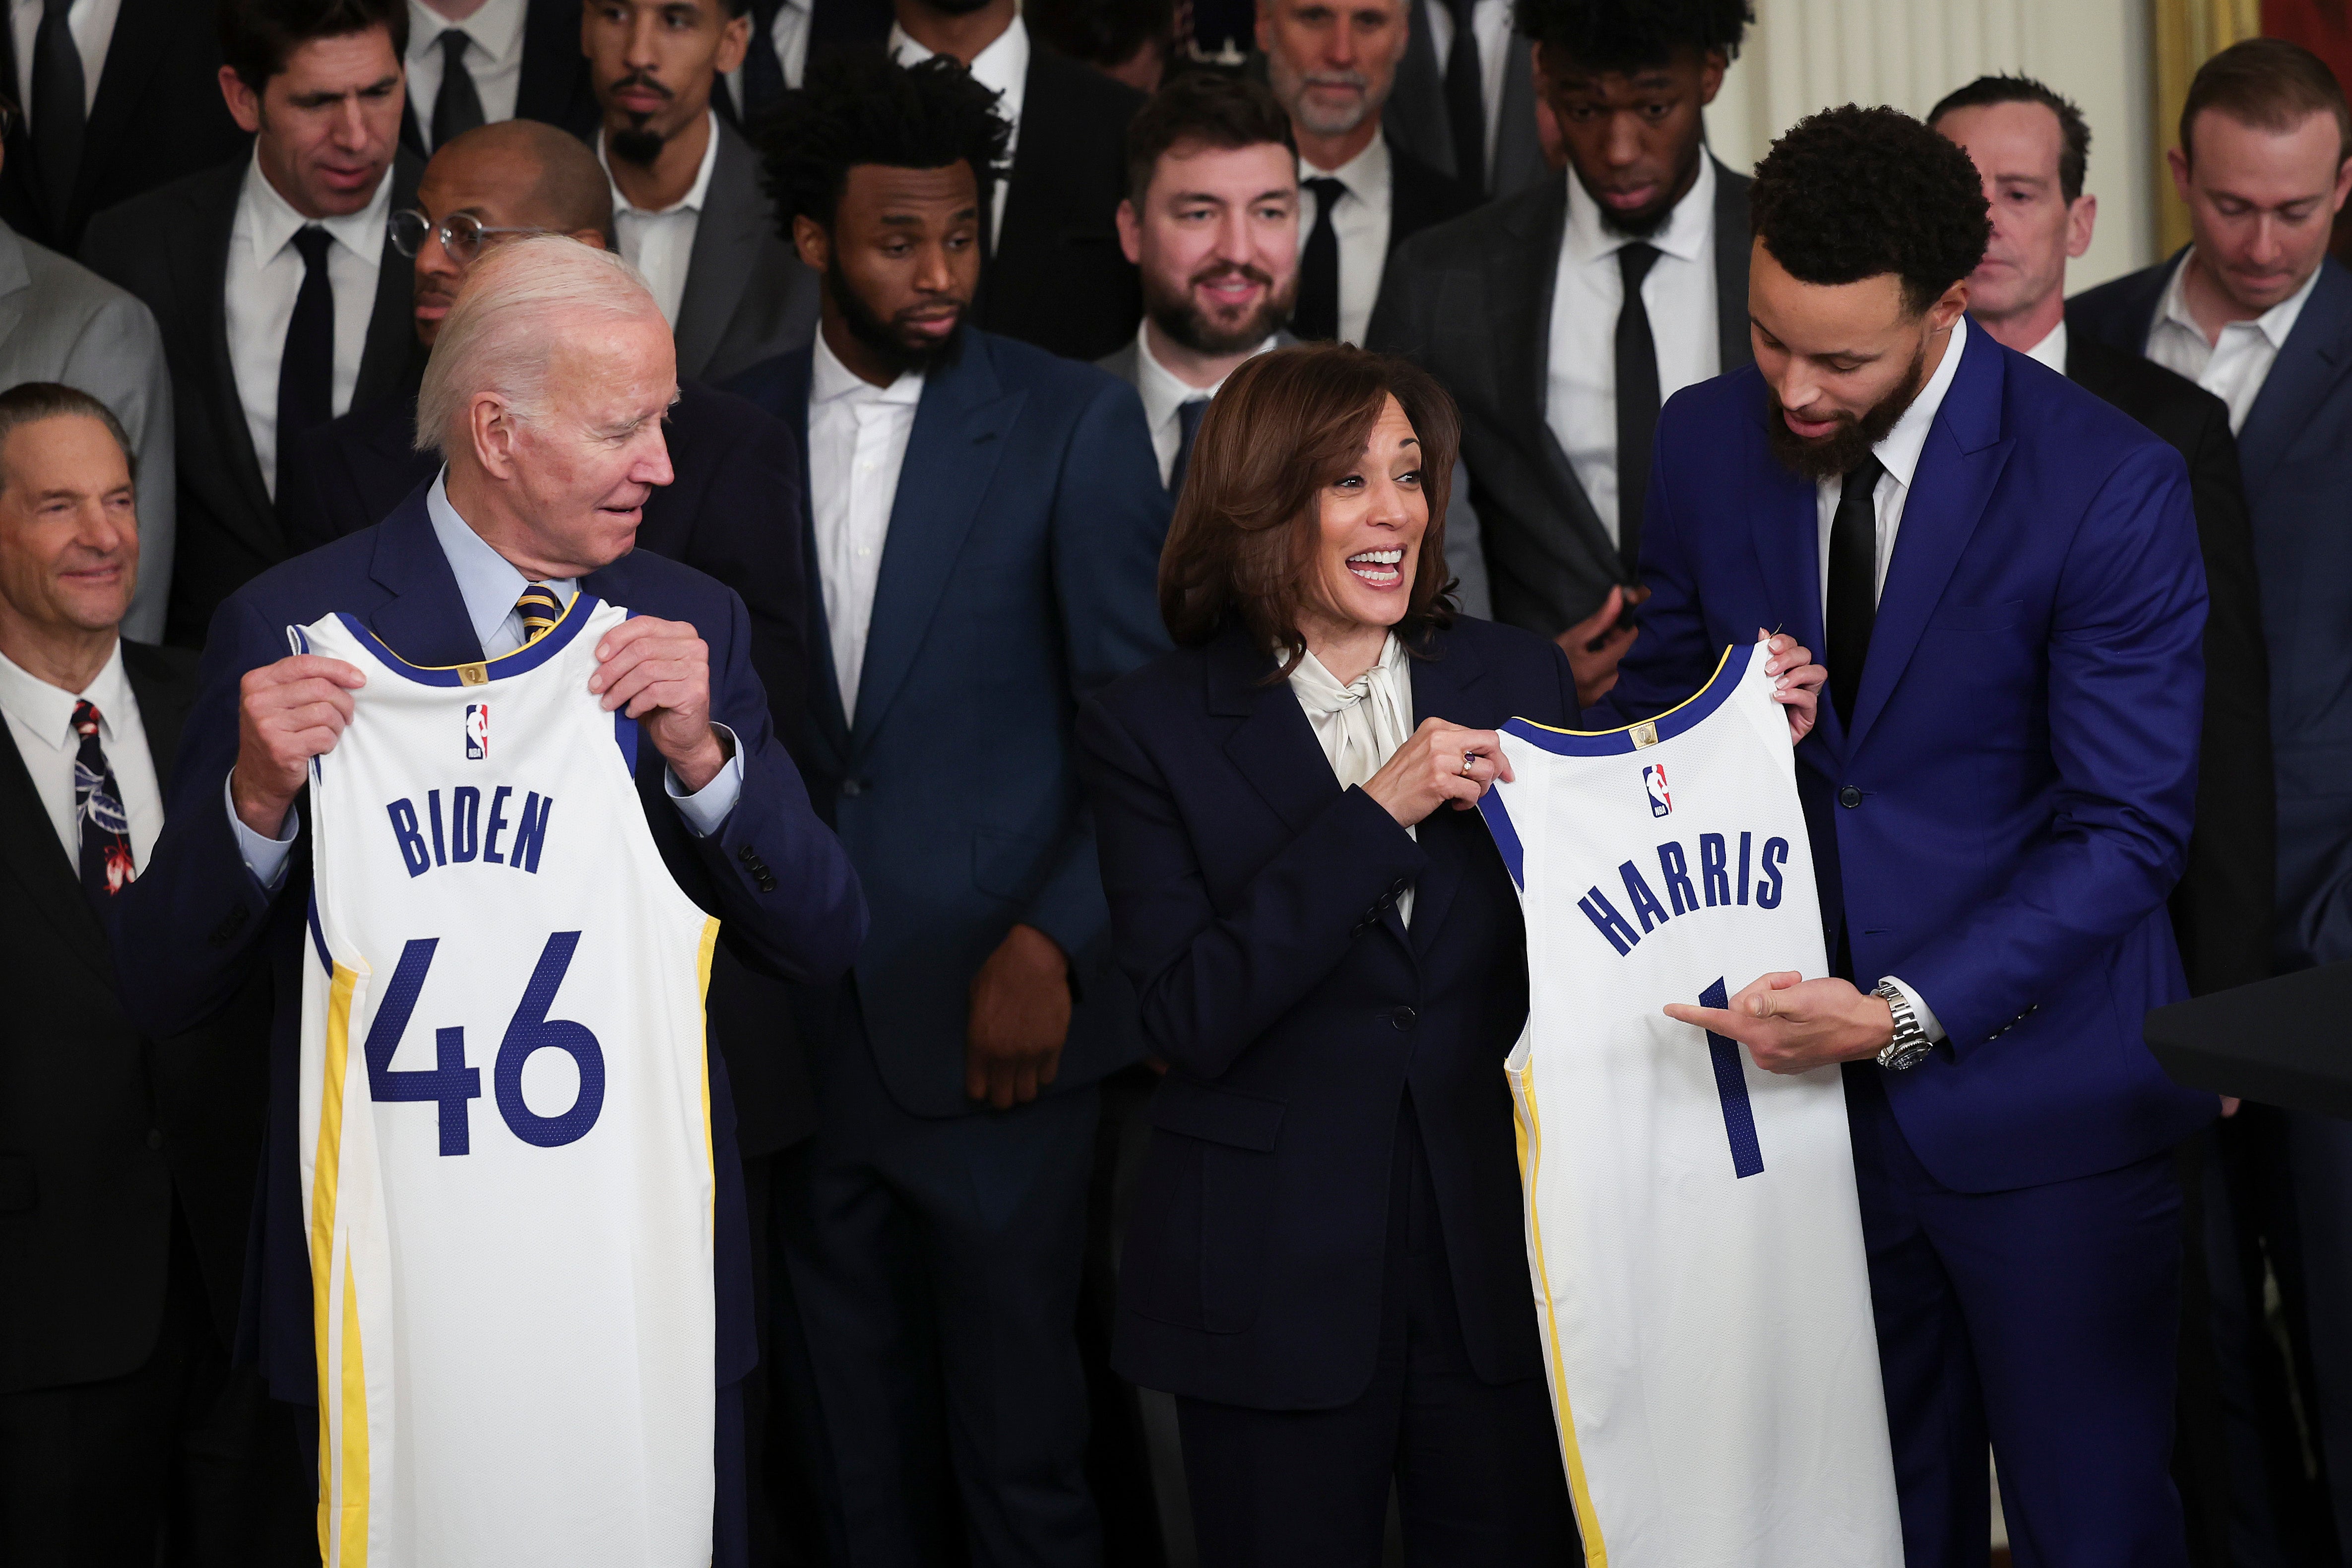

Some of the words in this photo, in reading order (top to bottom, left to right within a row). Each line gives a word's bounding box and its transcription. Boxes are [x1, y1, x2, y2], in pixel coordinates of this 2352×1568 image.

[386, 786, 553, 878] BIDEN
[1654, 805, 1666, 816] NBA
[1578, 831, 1789, 957] HARRIS
[365, 931, 605, 1156] 46
[1699, 976, 1764, 1179] 1
